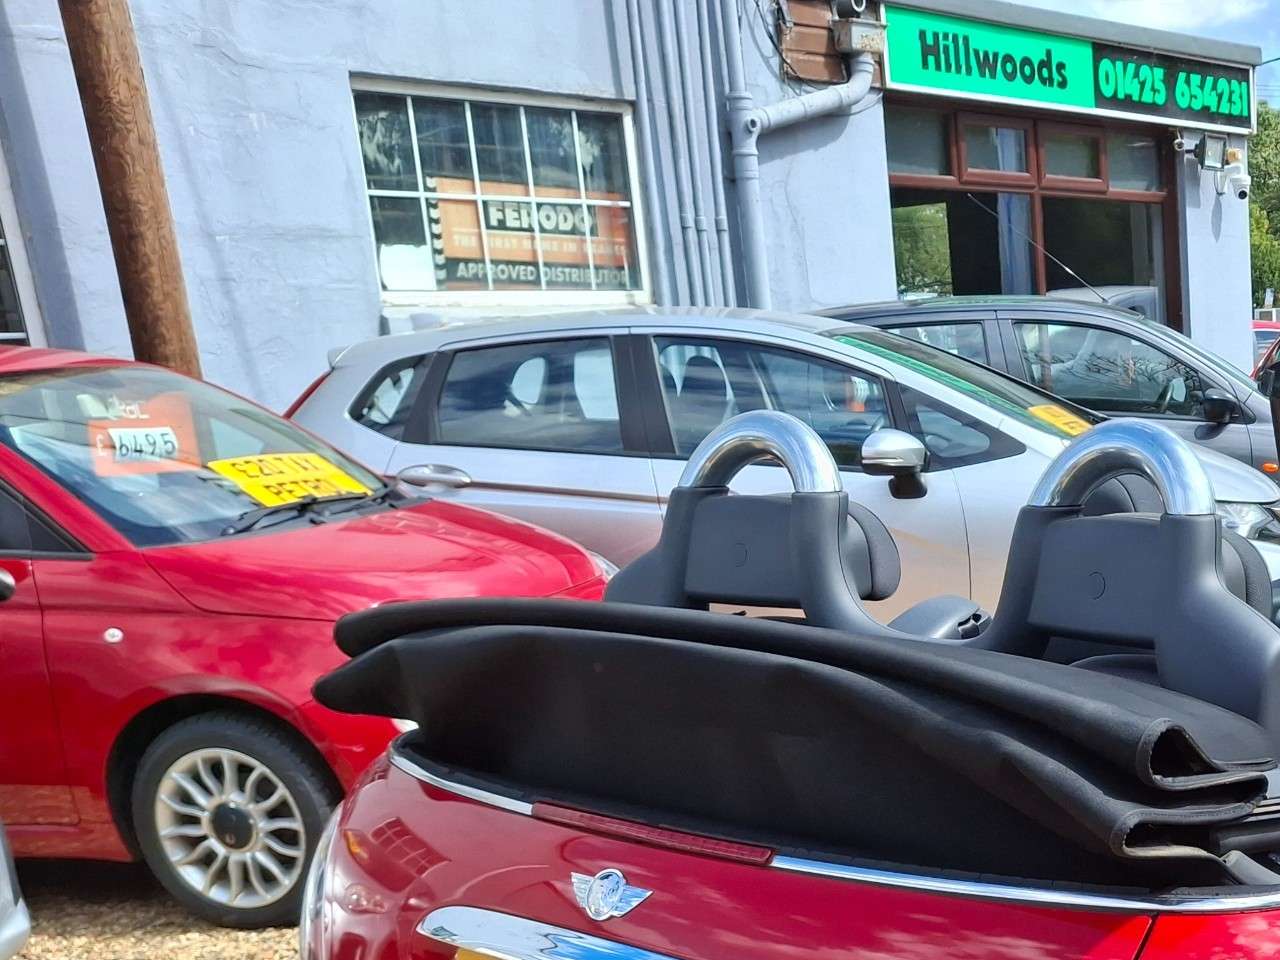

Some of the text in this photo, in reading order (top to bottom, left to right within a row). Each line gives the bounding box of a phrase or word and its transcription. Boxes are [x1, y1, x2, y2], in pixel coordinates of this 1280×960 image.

[918, 29, 1068, 90] Hillwoods
[1099, 57, 1249, 118] 01425 654231
[457, 262, 628, 284] APPROVED DISTRIBUTOR
[118, 432, 176, 457] 6495
